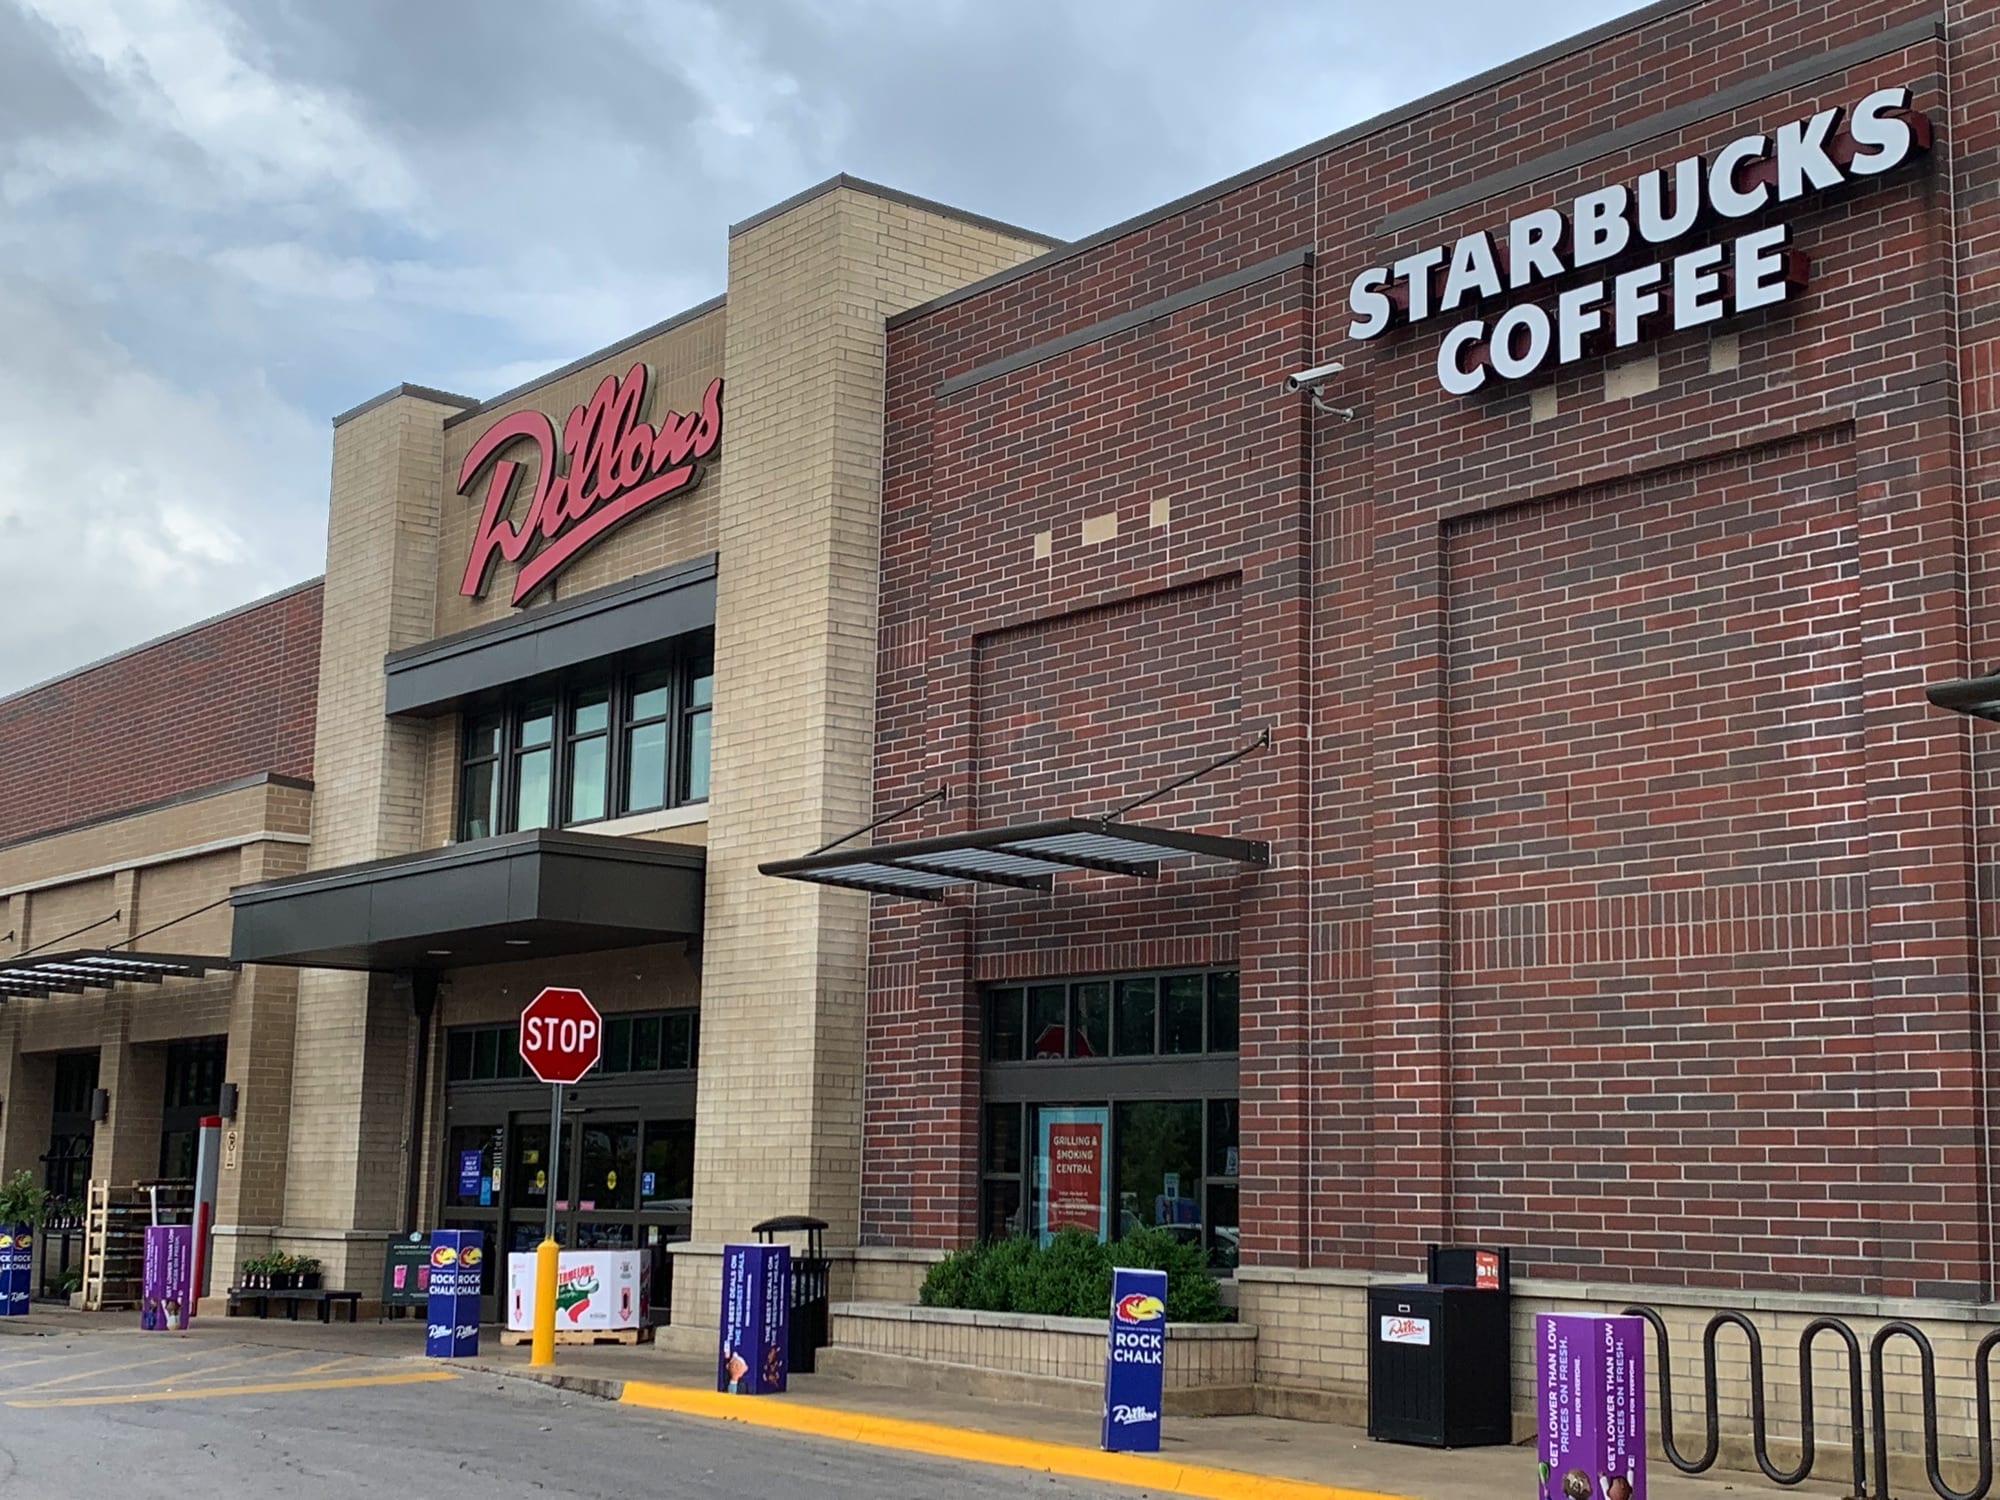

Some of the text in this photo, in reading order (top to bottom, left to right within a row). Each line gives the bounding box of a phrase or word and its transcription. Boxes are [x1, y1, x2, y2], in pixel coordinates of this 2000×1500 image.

[1348, 87, 1913, 340] STARBUCKS
[1437, 225, 1787, 395] COFFEE
[457, 362, 724, 607] Dillons
[526, 1016, 596, 1053] STOP
[1053, 1136, 1098, 1146] GRILLING &
[1056, 1150, 1094, 1160] SMOKING
[1056, 1164, 1093, 1174] CENTRAL
[730, 1255, 737, 1269] ON
[429, 1285, 455, 1295] CHALK
[430, 1274, 455, 1284] ROCK
[458, 1274, 480, 1284] ROCK
[729, 1270, 737, 1299] DEALS
[457, 1285, 480, 1296] CHALK
[735, 1284, 743, 1328] FRESHEST
[1116, 1333, 1161, 1349] ROCK
[1114, 1349, 1162, 1364] CHALK
[1548, 1319, 1559, 1468] GET LOWER THAN LOW
[1559, 1336, 1569, 1453] PRICES ON FRESH.
[1605, 1323, 1616, 1471] GET LOWER THAN LOW
[1616, 1338, 1625, 1455] PRICES ON FRESH.
